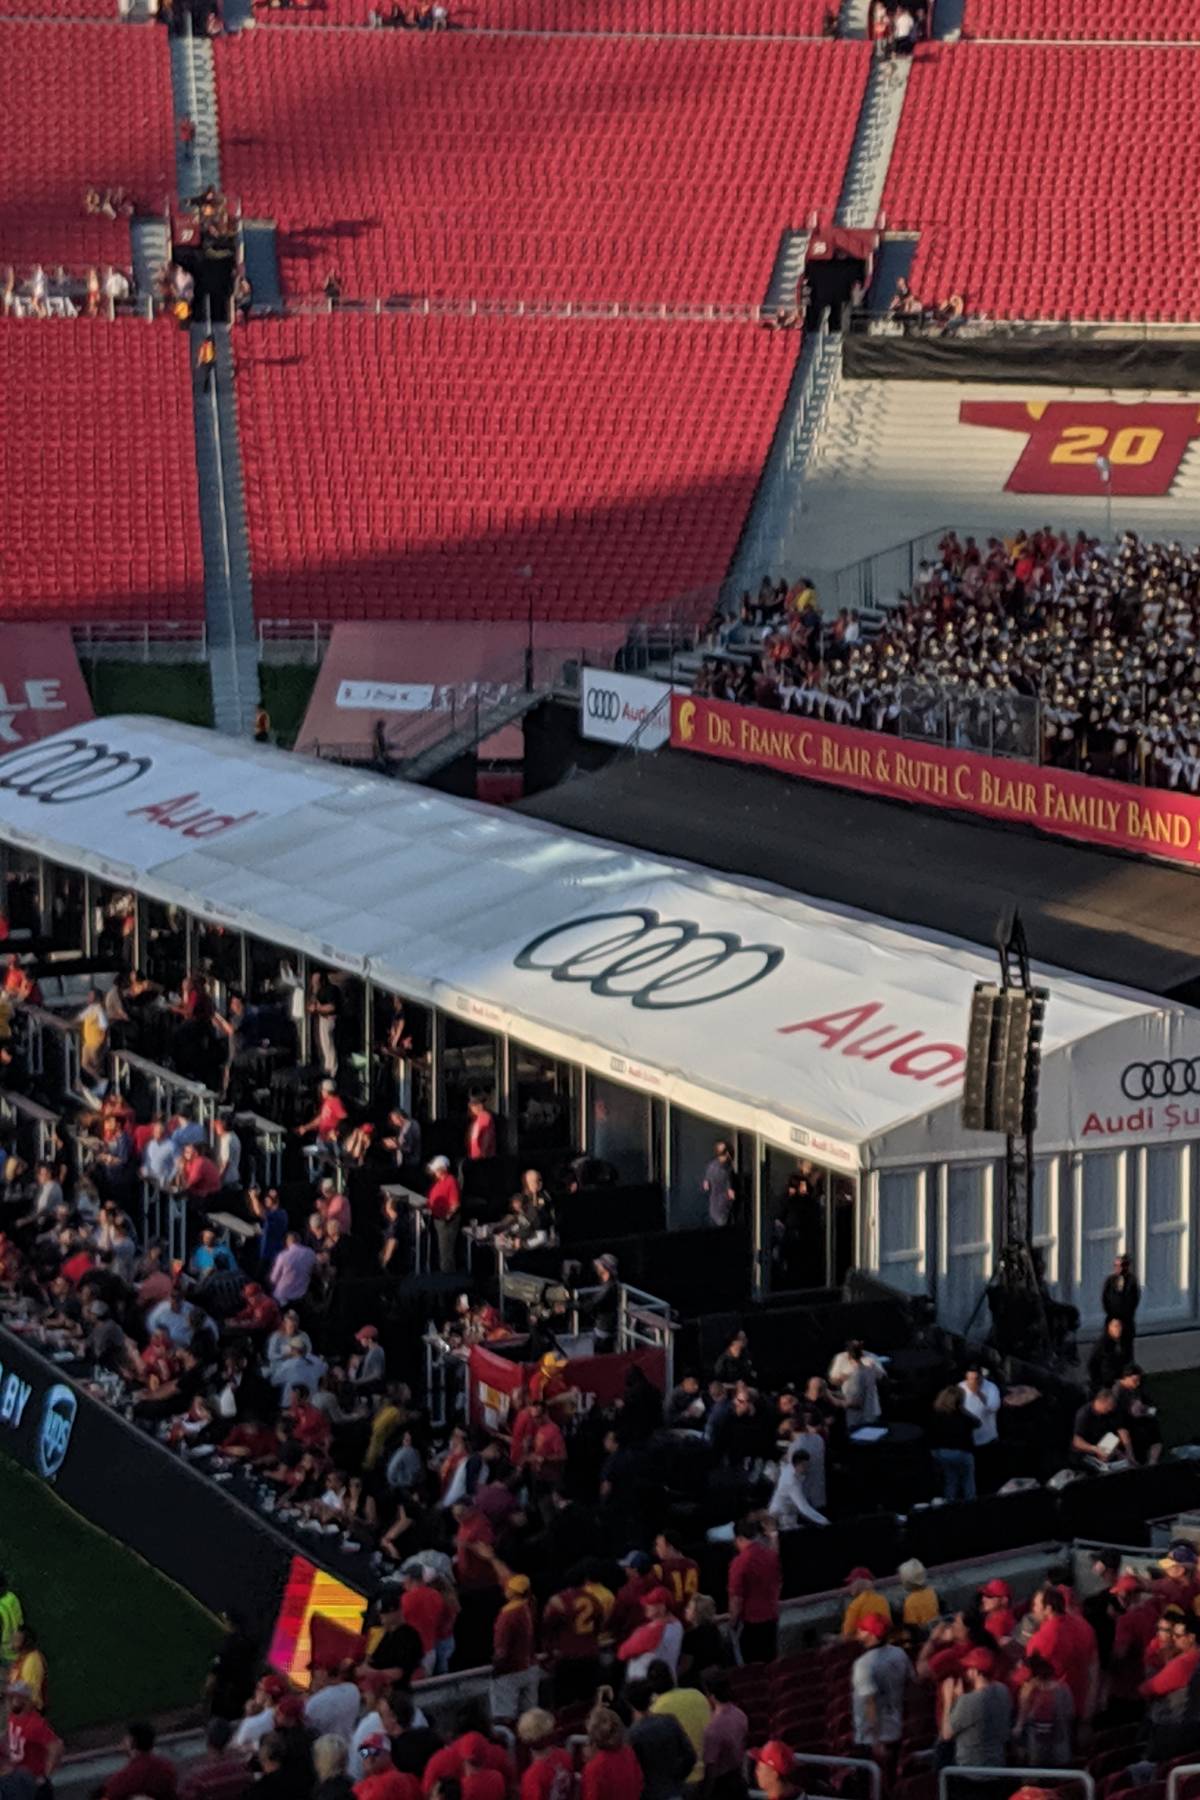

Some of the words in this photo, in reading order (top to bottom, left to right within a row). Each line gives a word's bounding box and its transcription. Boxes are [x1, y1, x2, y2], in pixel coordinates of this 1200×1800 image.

[1050, 426, 1165, 464] 20
[708, 711, 735, 747] DR.
[741, 720, 795, 762] FRANK
[822, 735, 873, 779] BLAIR
[875, 749, 890, 782] &
[895, 752, 949, 796] RUTH
[981, 770, 1037, 815] BLAIR
[1043, 783, 1121, 833] FAMILY
[1127, 801, 1192, 849] BAND
[1081, 1106, 1154, 1137] Audi
[1, 1372, 32, 1429] BY
